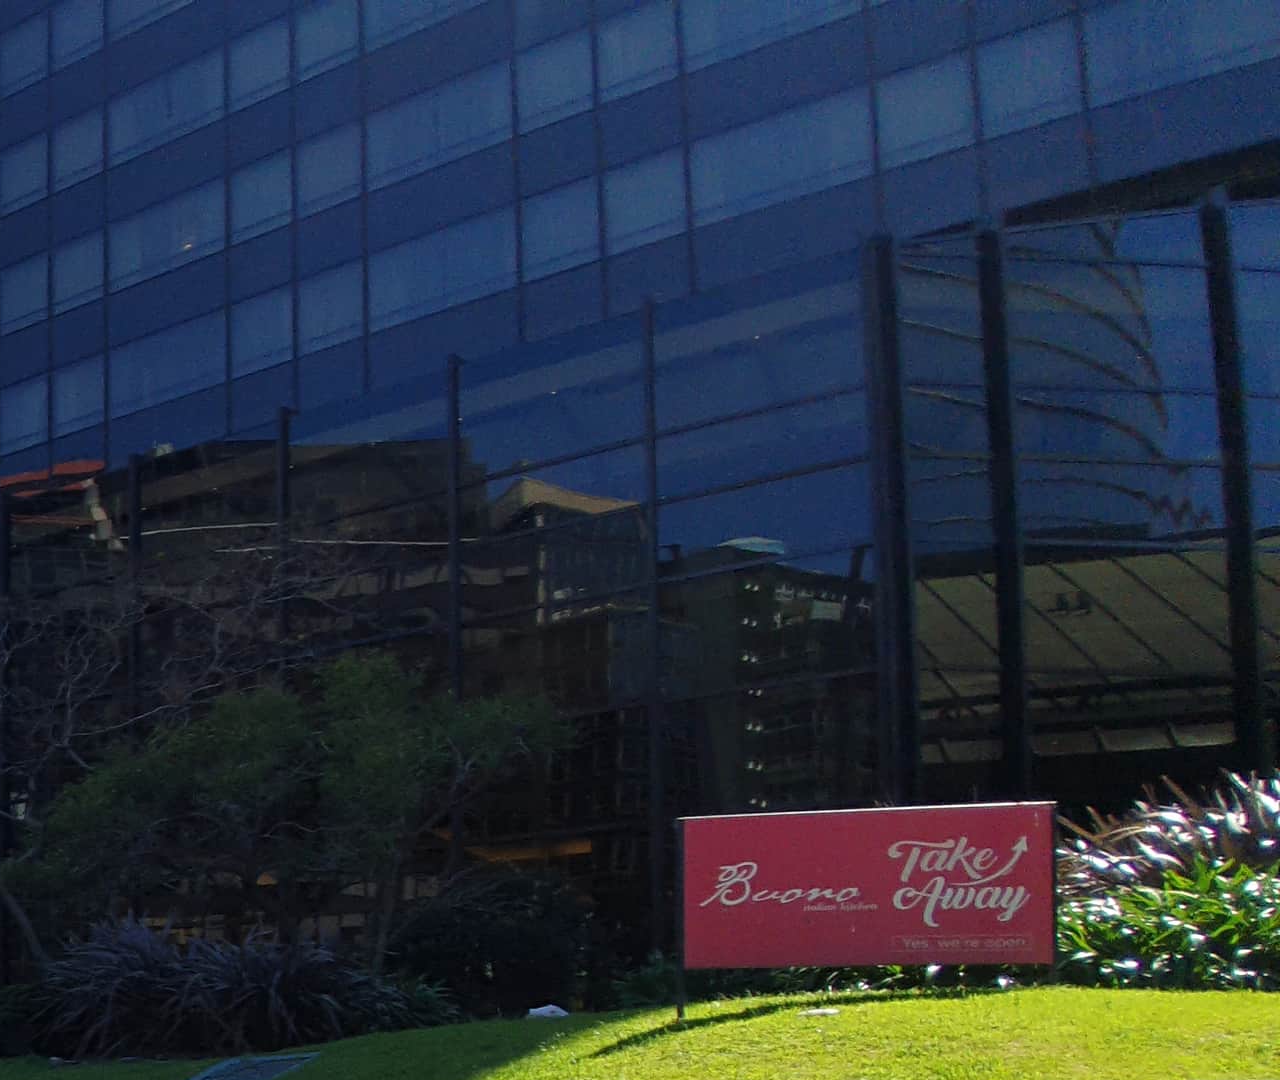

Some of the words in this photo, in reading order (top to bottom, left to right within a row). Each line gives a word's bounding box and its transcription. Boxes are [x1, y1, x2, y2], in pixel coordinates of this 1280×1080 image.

[887, 836, 999, 882] Take
[699, 861, 861, 907] Buono
[892, 876, 1031, 928] Away
